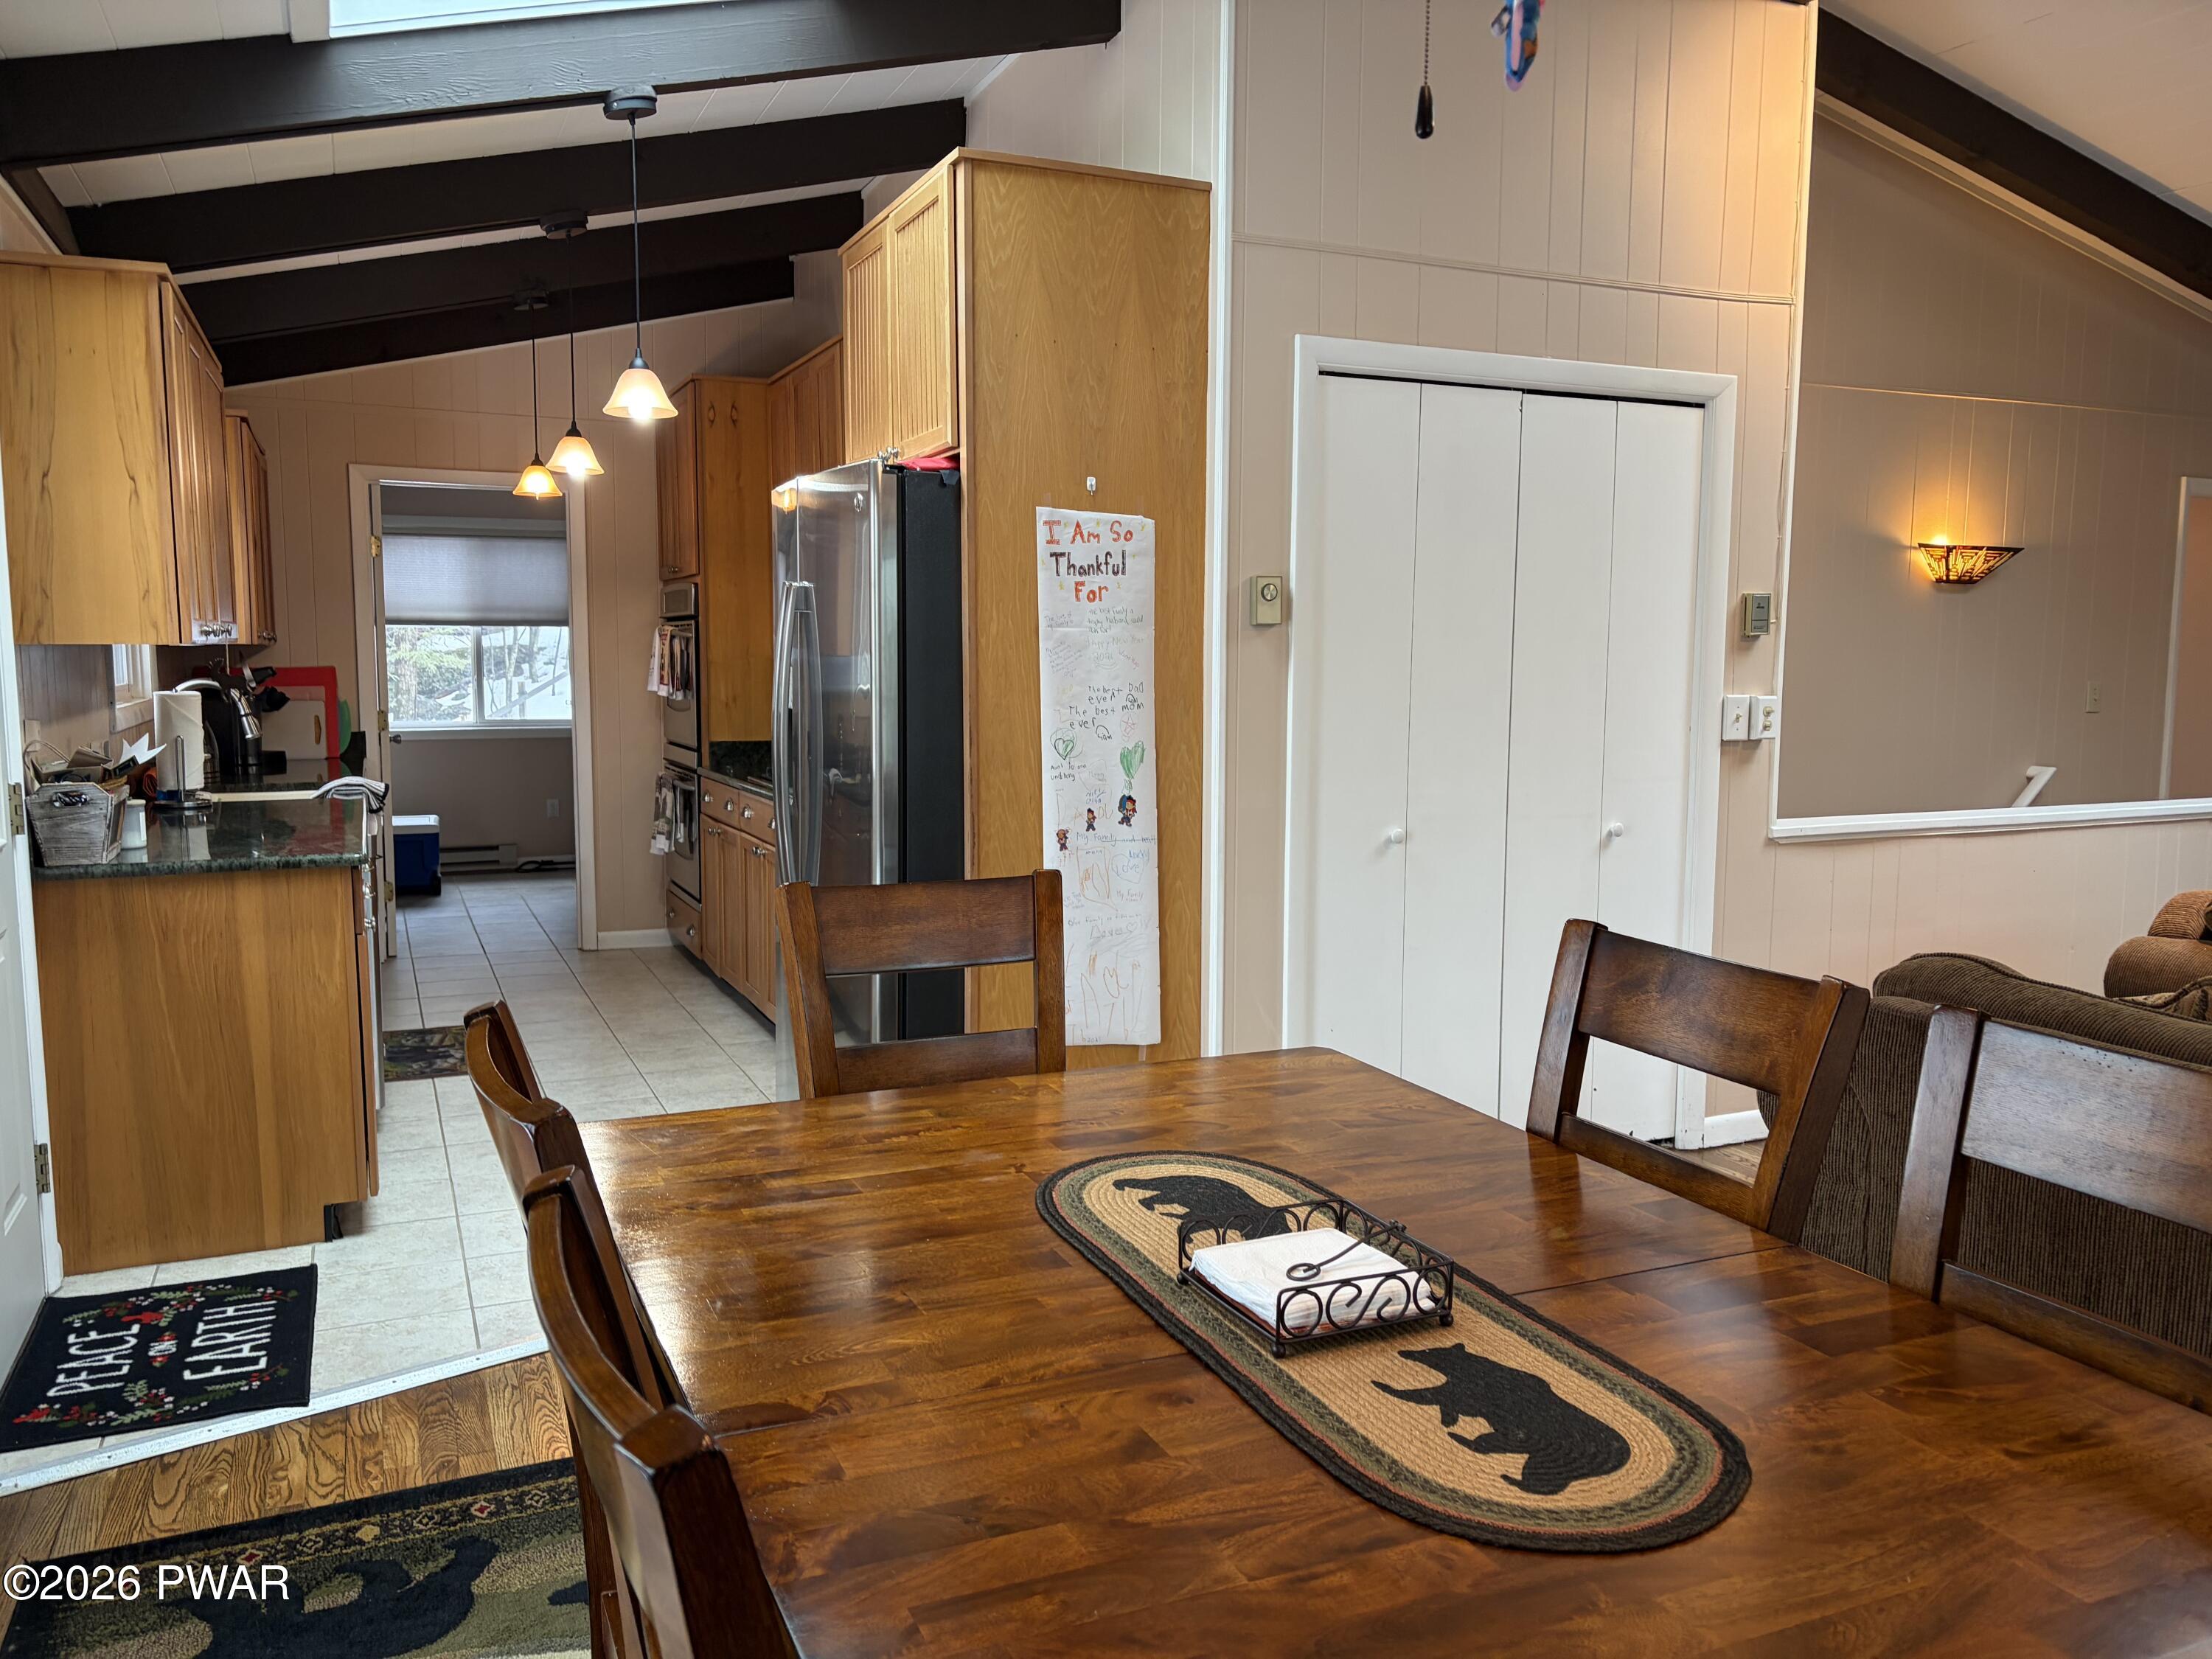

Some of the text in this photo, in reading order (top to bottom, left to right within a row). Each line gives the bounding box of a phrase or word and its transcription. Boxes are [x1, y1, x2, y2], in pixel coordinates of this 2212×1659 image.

[1043, 519, 1133, 545] I Am So
[1049, 549, 1127, 577] Thankful
[1074, 580, 1109, 603] For
[147, 1339, 178, 1357] ON
[183, 1300, 278, 1381] EARTH
[46, 1323, 141, 1397] PEACE
